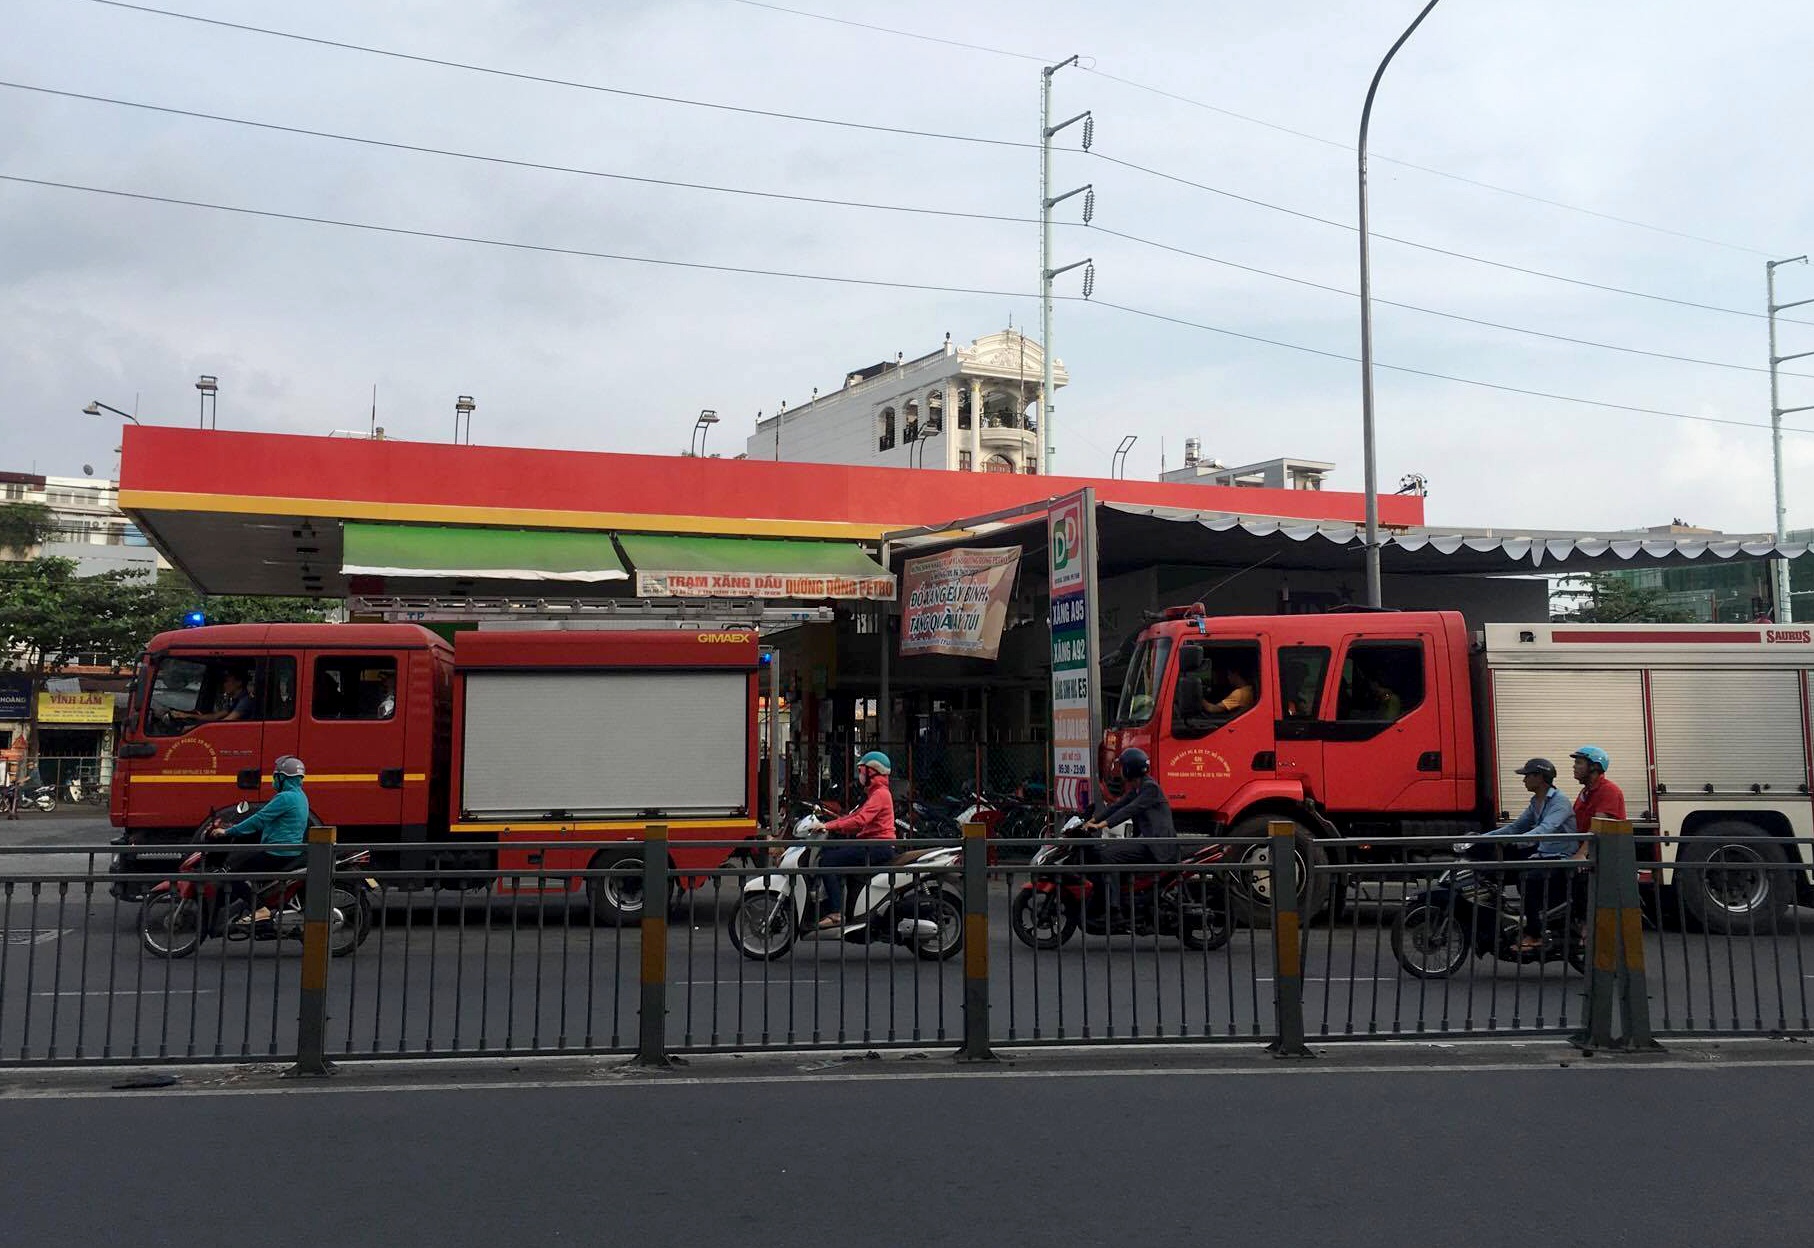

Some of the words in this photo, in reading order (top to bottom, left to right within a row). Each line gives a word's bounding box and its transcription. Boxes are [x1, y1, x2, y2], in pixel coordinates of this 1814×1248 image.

[668, 576, 708, 589] TRẠM
[712, 574, 751, 588] XĂNG
[859, 579, 894, 597] PETRO
[1053, 601, 1070, 625] XĂNG
[1071, 600, 1084, 622] A95
[697, 633, 750, 643] GIMAEX
[1766, 630, 1811, 644] SAURUS
[1054, 639, 1071, 664] XĂNG
[1072, 639, 1086, 660] A92
[1078, 678, 1087, 698] E5
